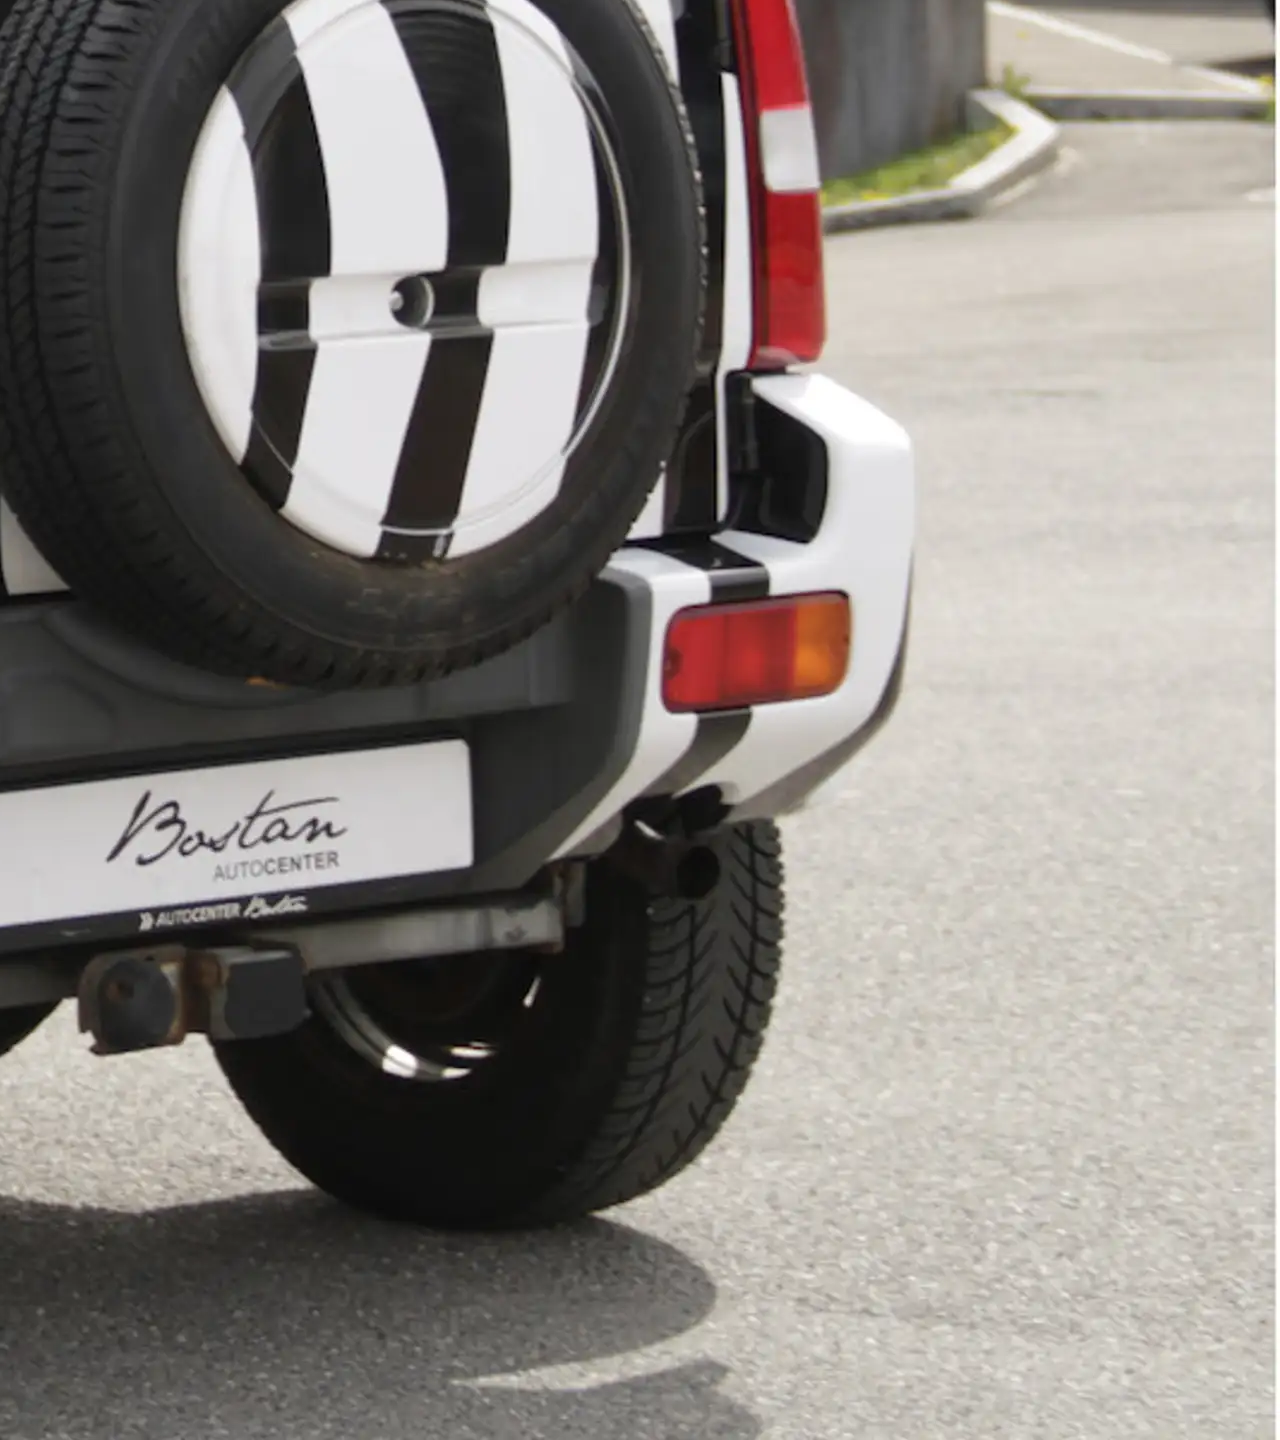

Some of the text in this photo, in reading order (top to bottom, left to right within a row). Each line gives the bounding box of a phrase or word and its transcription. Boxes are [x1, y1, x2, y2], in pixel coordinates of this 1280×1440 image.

[106, 789, 347, 867] Bostan
[212, 850, 340, 882] AUTOCENTER
[155, 901, 241, 928] AUTOCENTER
